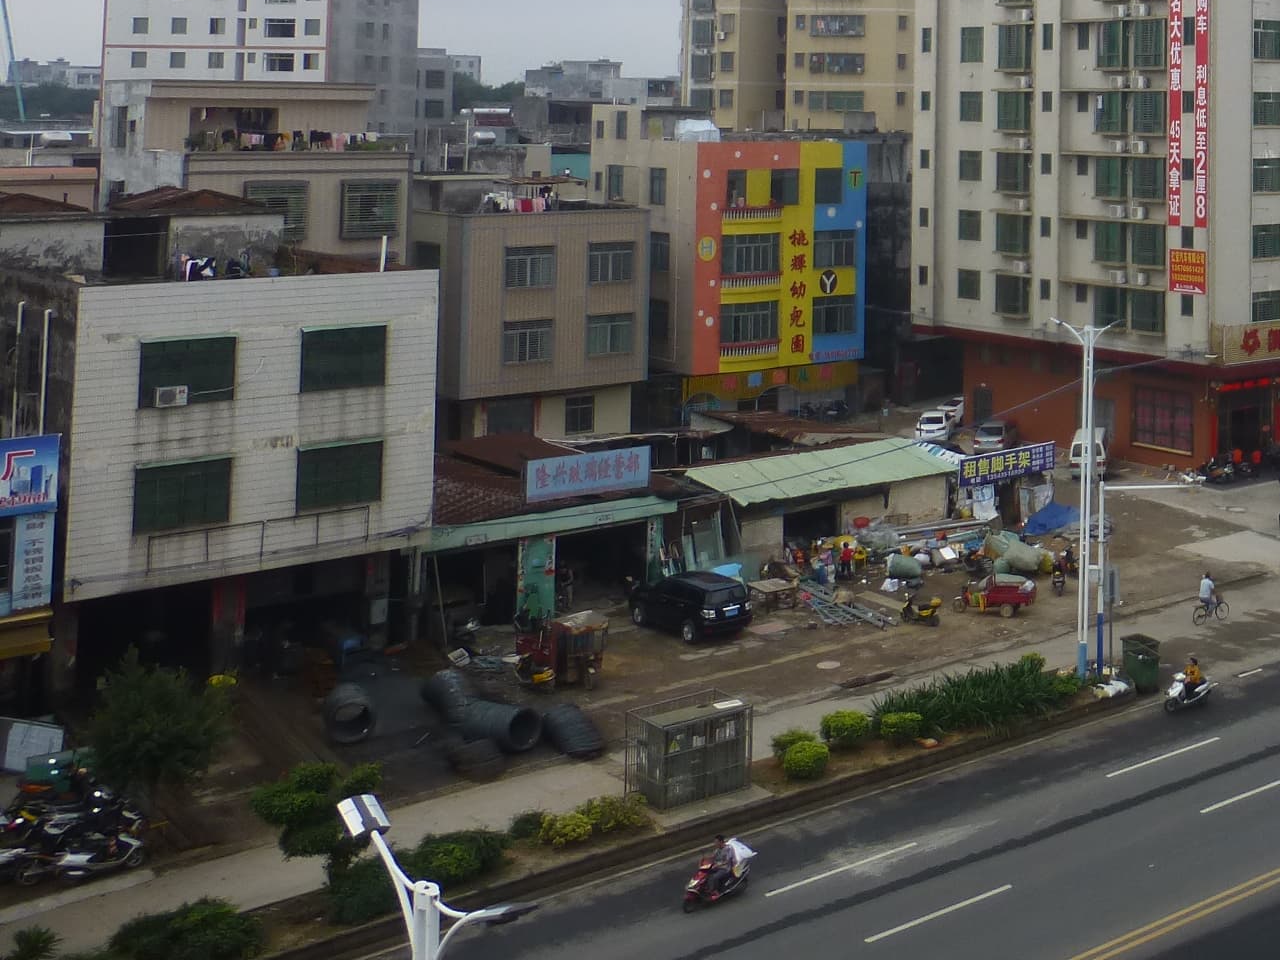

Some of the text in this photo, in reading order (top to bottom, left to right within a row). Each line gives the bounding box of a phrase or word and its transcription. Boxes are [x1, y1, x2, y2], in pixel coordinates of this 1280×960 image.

[1195, 64, 1207, 218] 利息低至2厘8
[850, 171, 861, 187] T
[1169, 120, 1181, 216] 45天拿证
[701, 240, 713, 256] H
[821, 273, 836, 294] Y
[963, 451, 1031, 478] 租售脚手架
